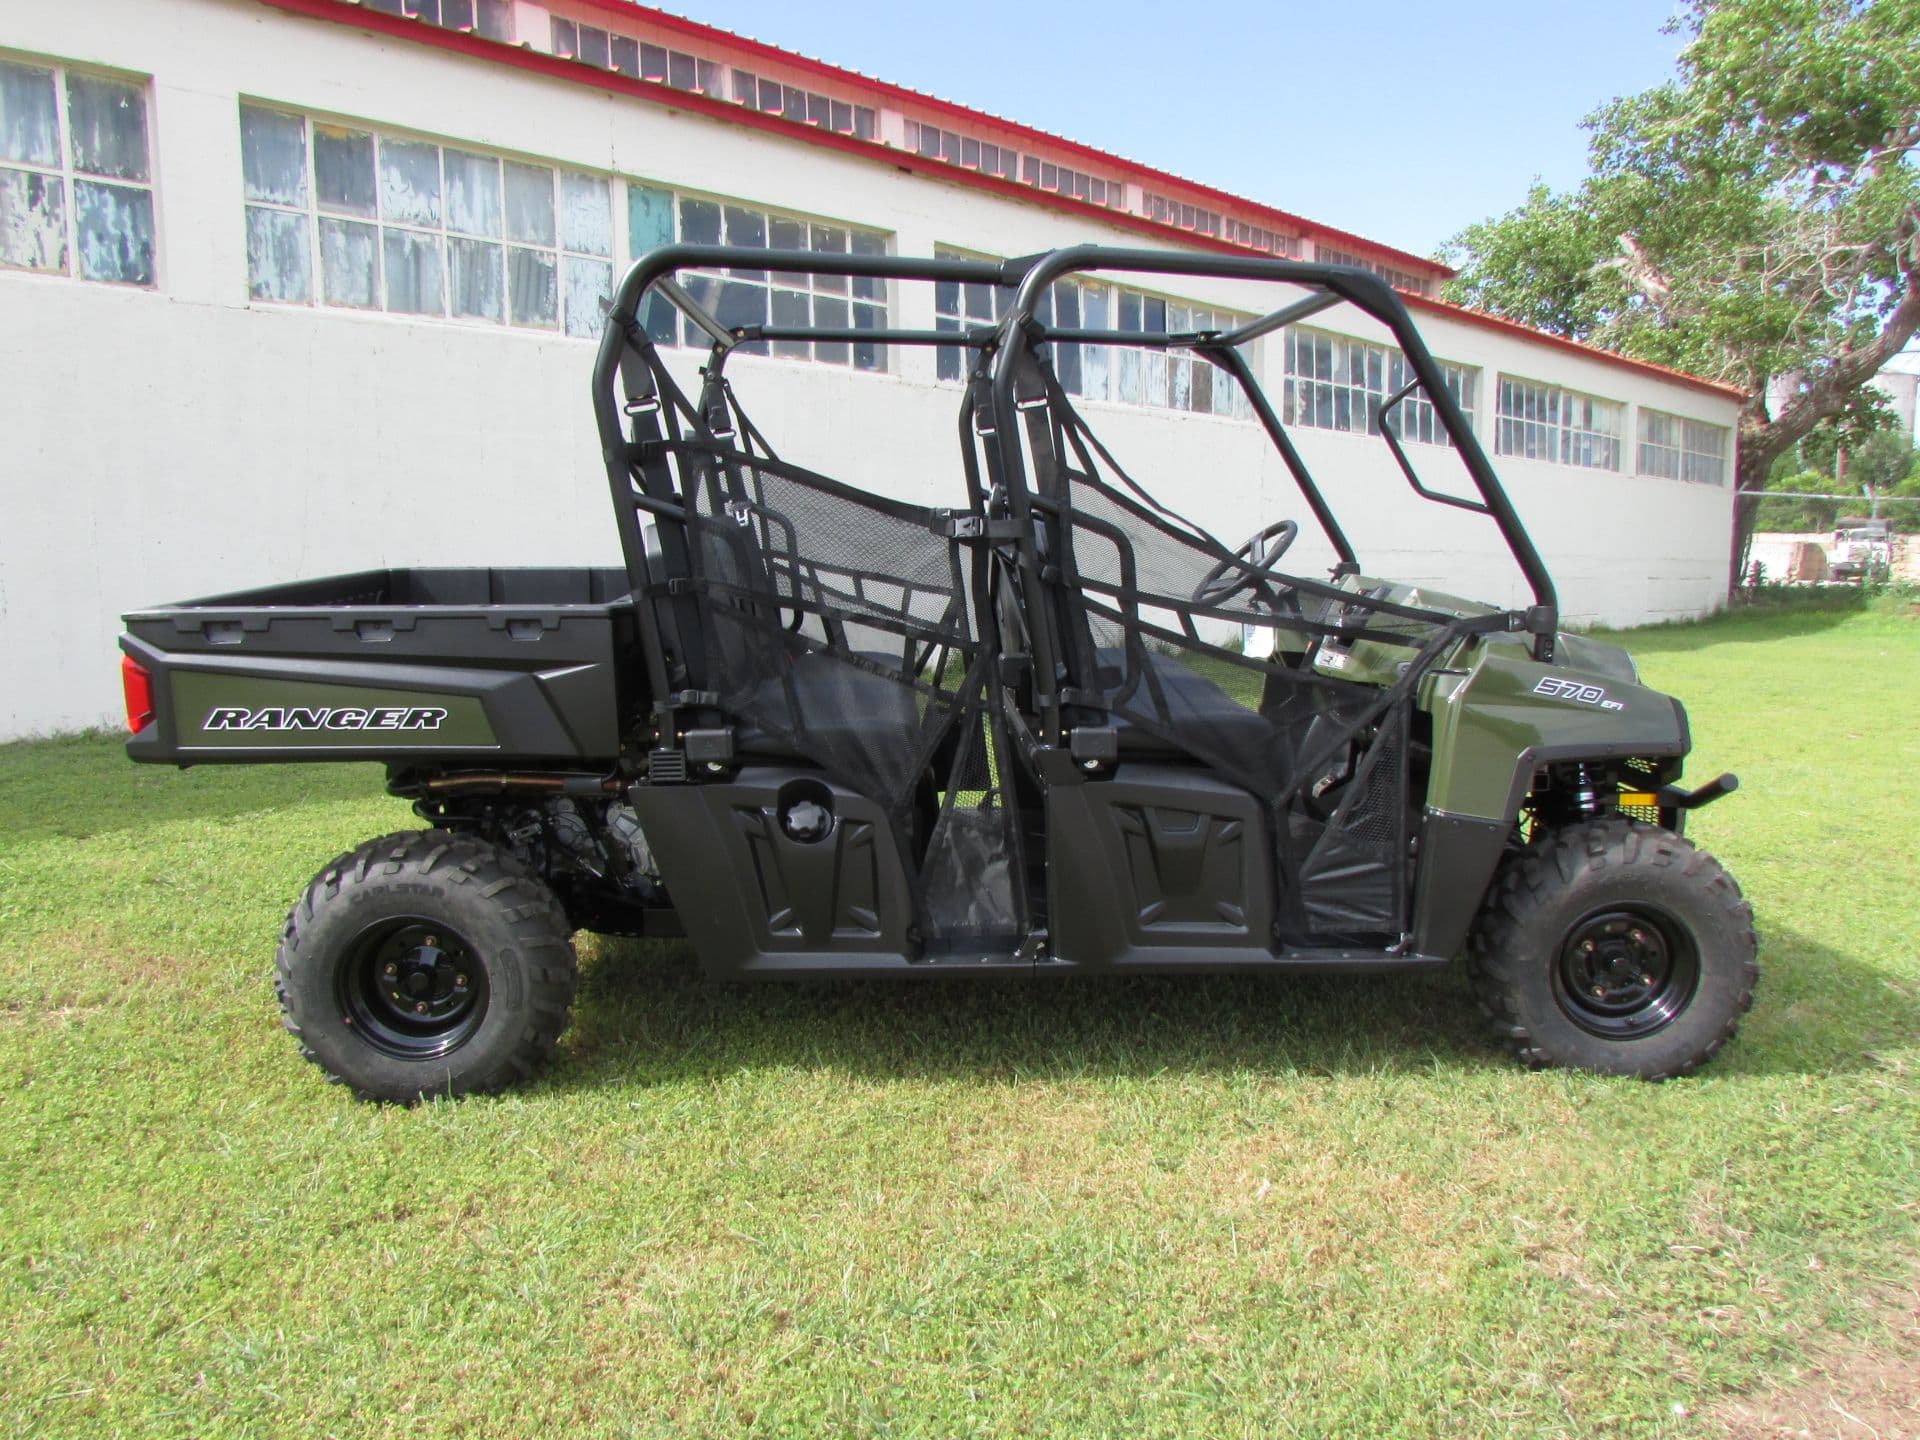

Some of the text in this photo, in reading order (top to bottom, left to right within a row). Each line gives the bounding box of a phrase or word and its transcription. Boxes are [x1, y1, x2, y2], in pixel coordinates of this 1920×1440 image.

[1533, 677, 1624, 711] 570 EFI
[203, 707, 447, 730] RANGER
